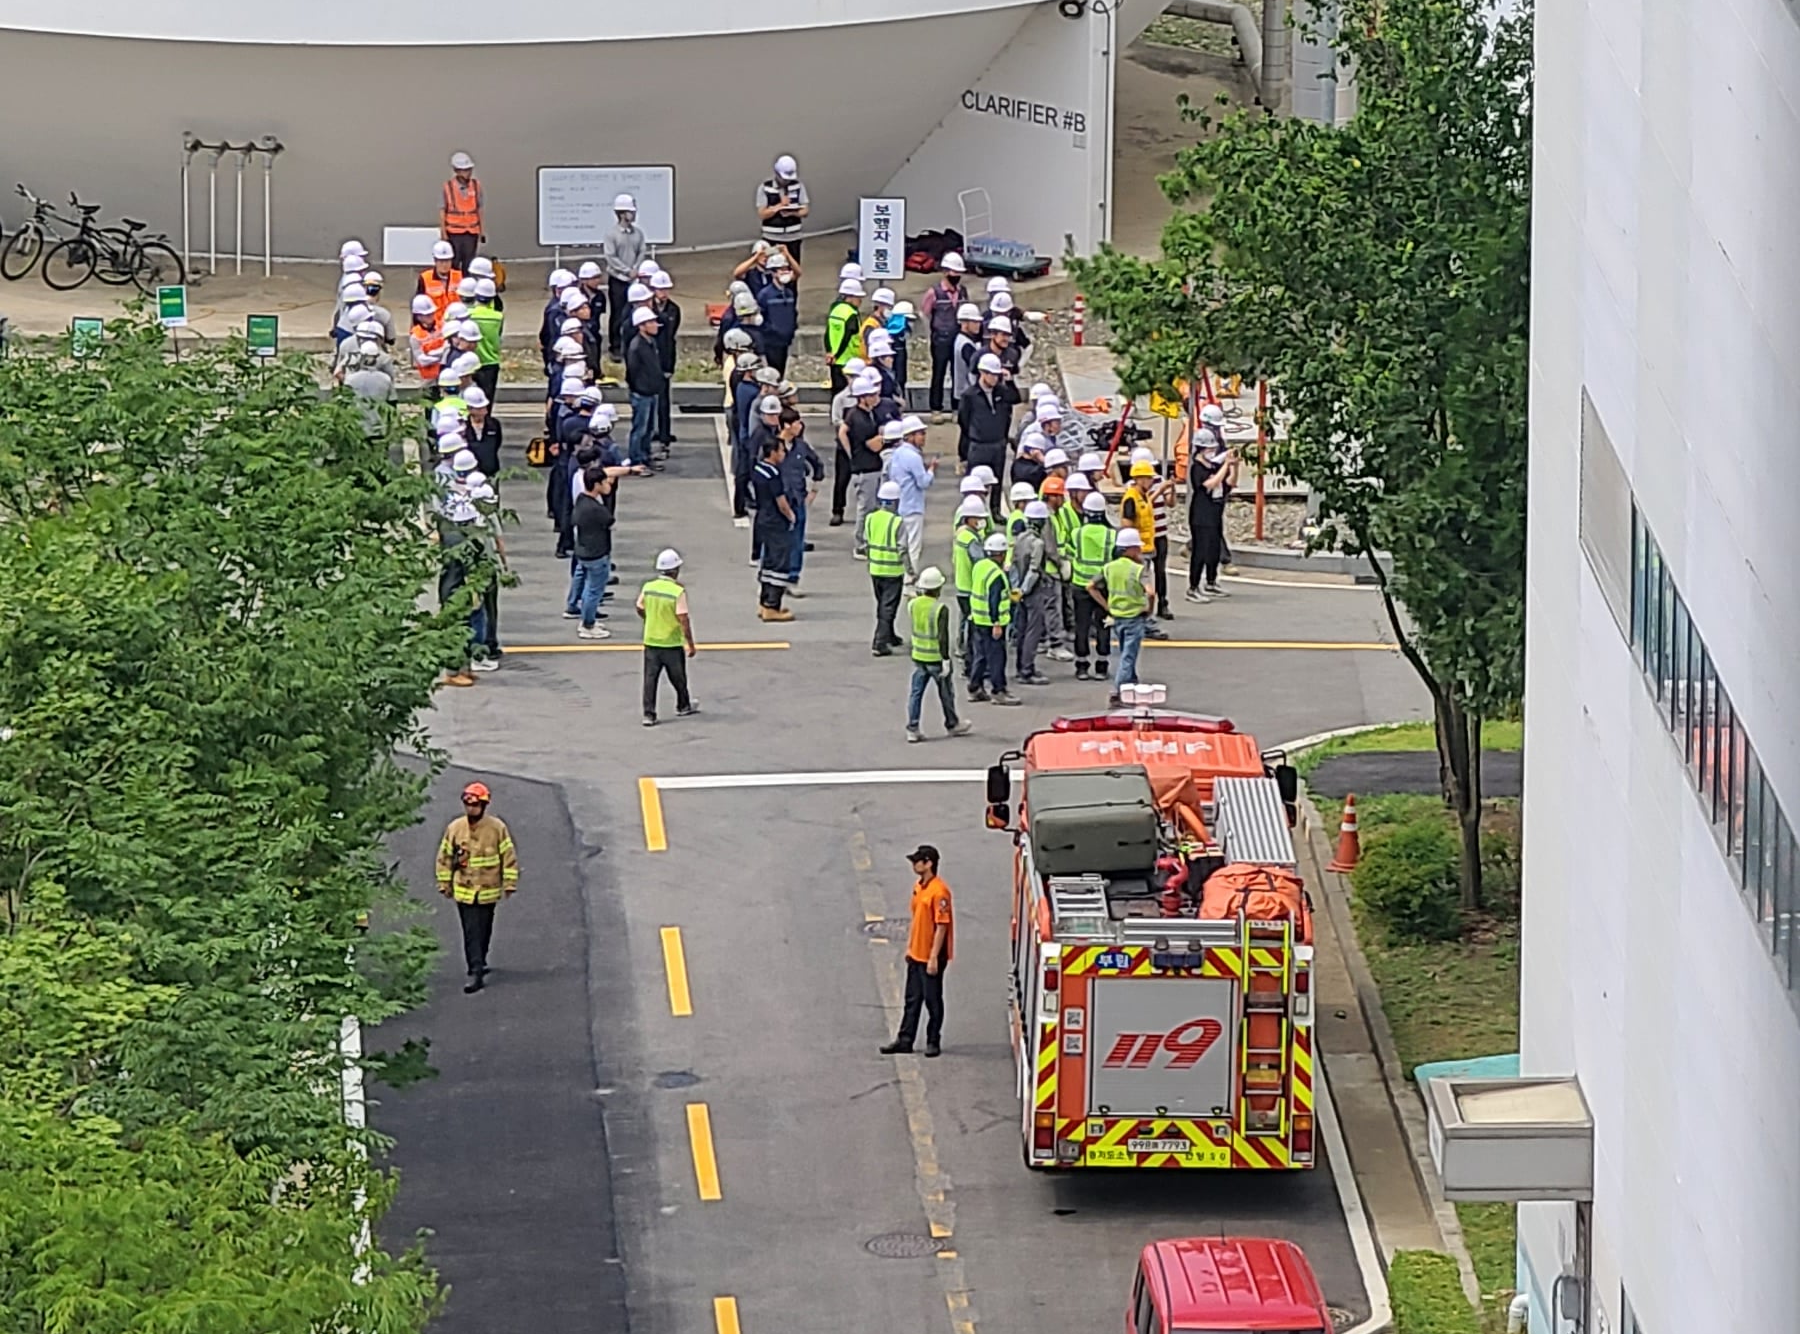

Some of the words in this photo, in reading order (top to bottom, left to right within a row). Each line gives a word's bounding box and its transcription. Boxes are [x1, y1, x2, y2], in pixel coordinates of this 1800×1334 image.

[961, 89, 1058, 128] CLARIFIER
[1062, 110, 1086, 133] #B
[873, 204, 891, 243] 보행자
[1101, 1017, 1223, 1069] 119
